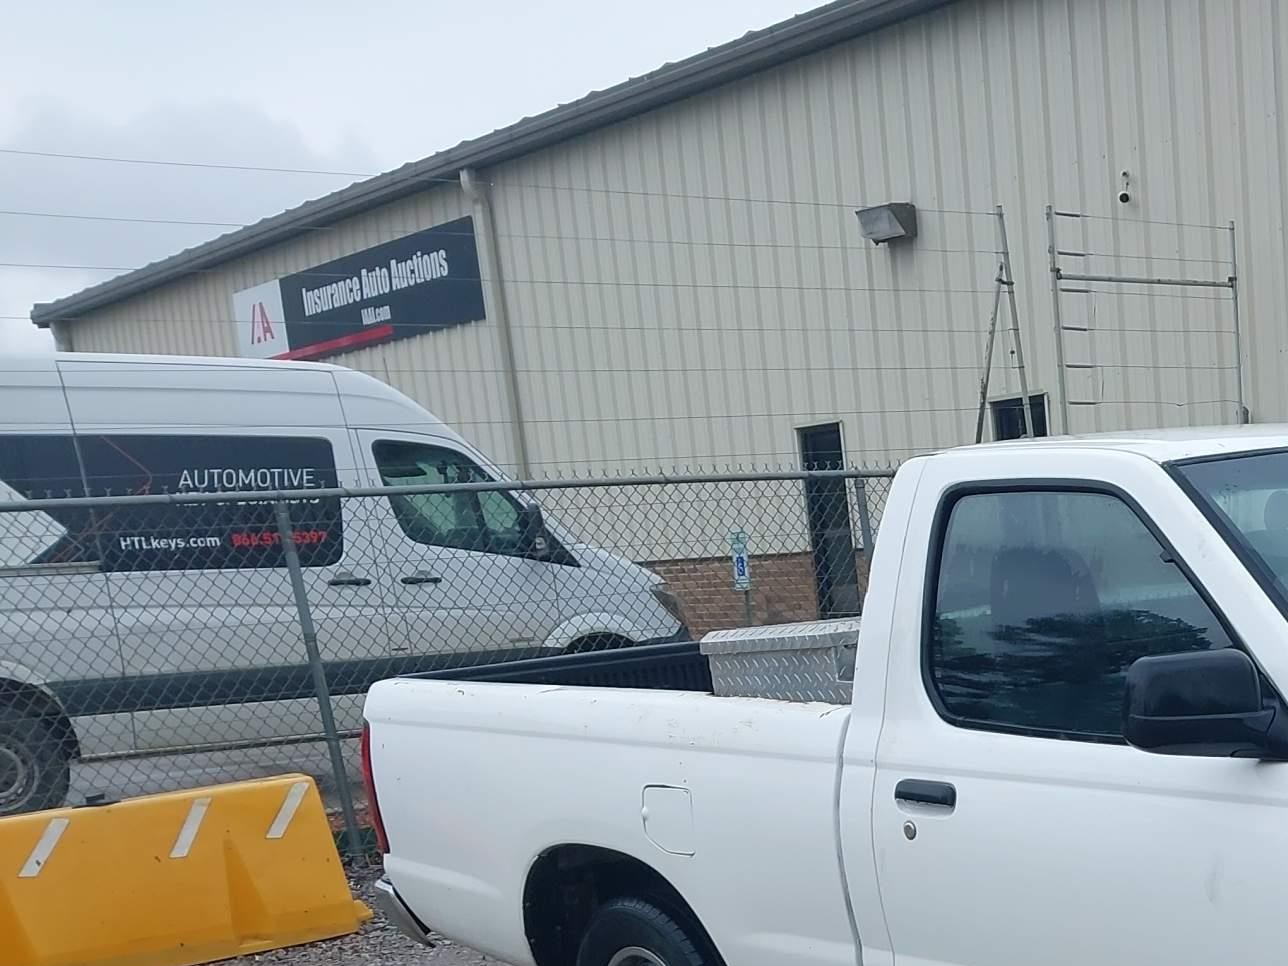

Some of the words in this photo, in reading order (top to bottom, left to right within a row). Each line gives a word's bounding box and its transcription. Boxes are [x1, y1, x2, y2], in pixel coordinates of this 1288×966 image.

[302, 278, 361, 317] Insurance
[361, 266, 390, 300] Auto
[390, 247, 449, 291] Auctions
[178, 468, 316, 488] AUTOMOTIVE
[119, 534, 221, 552] HTLkeys.com
